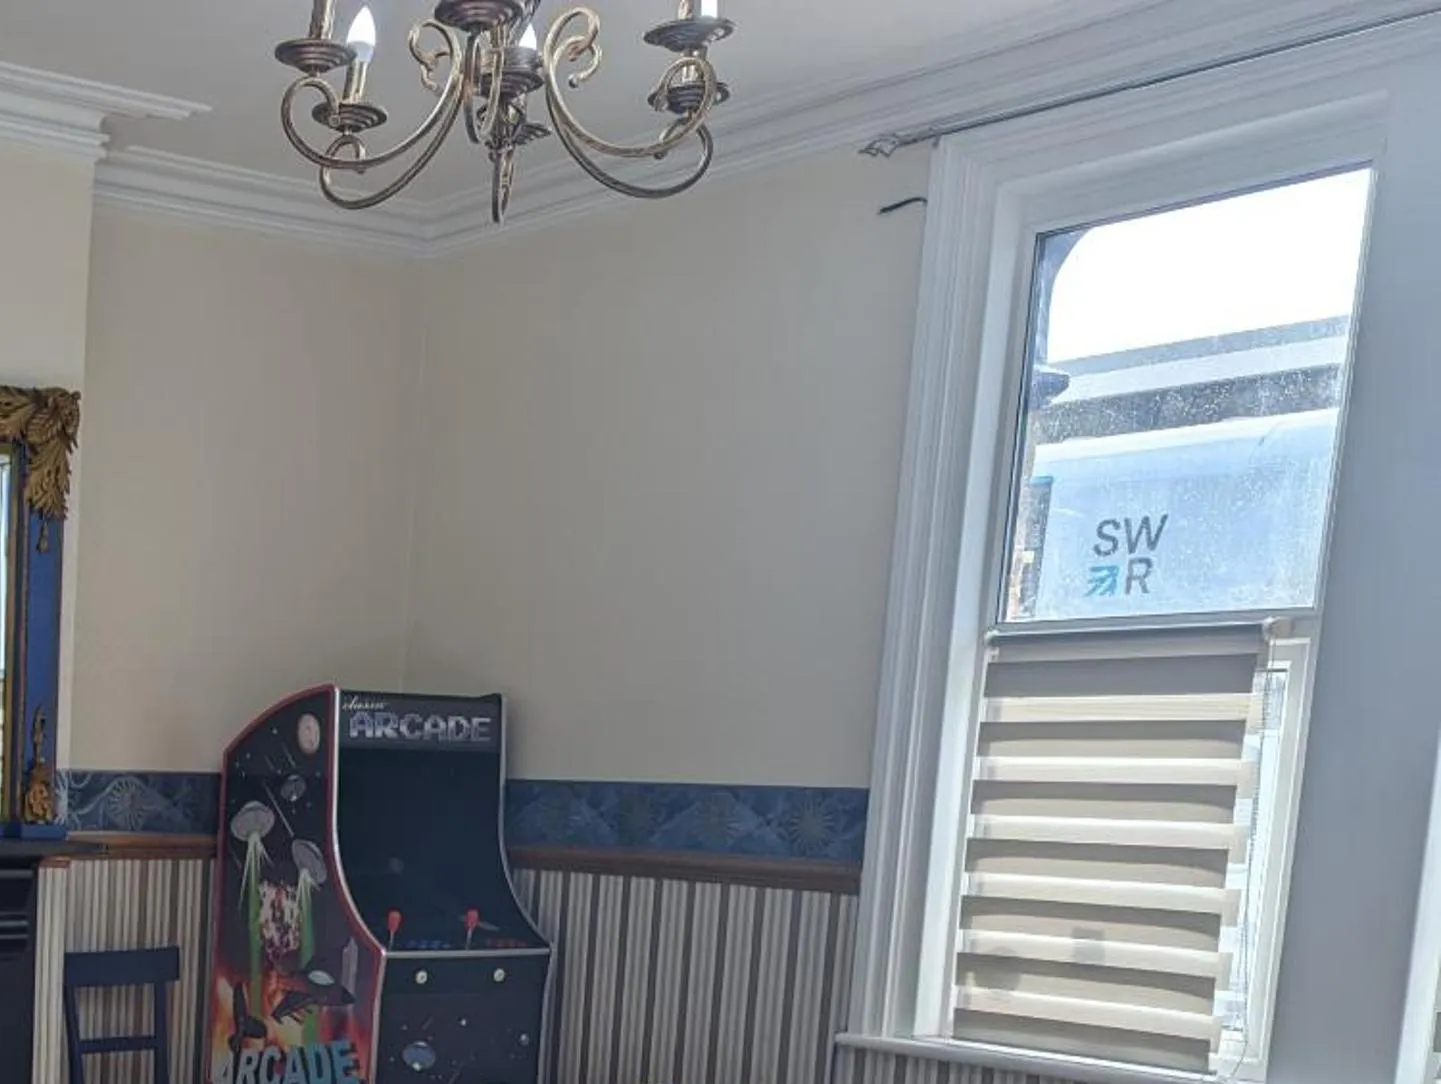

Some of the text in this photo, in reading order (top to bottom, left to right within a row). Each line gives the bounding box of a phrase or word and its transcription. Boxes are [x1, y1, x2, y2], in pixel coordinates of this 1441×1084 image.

[1093, 514, 1168, 556] SW
[1125, 558, 1153, 595] R
[349, 711, 492, 742] ARCADE
